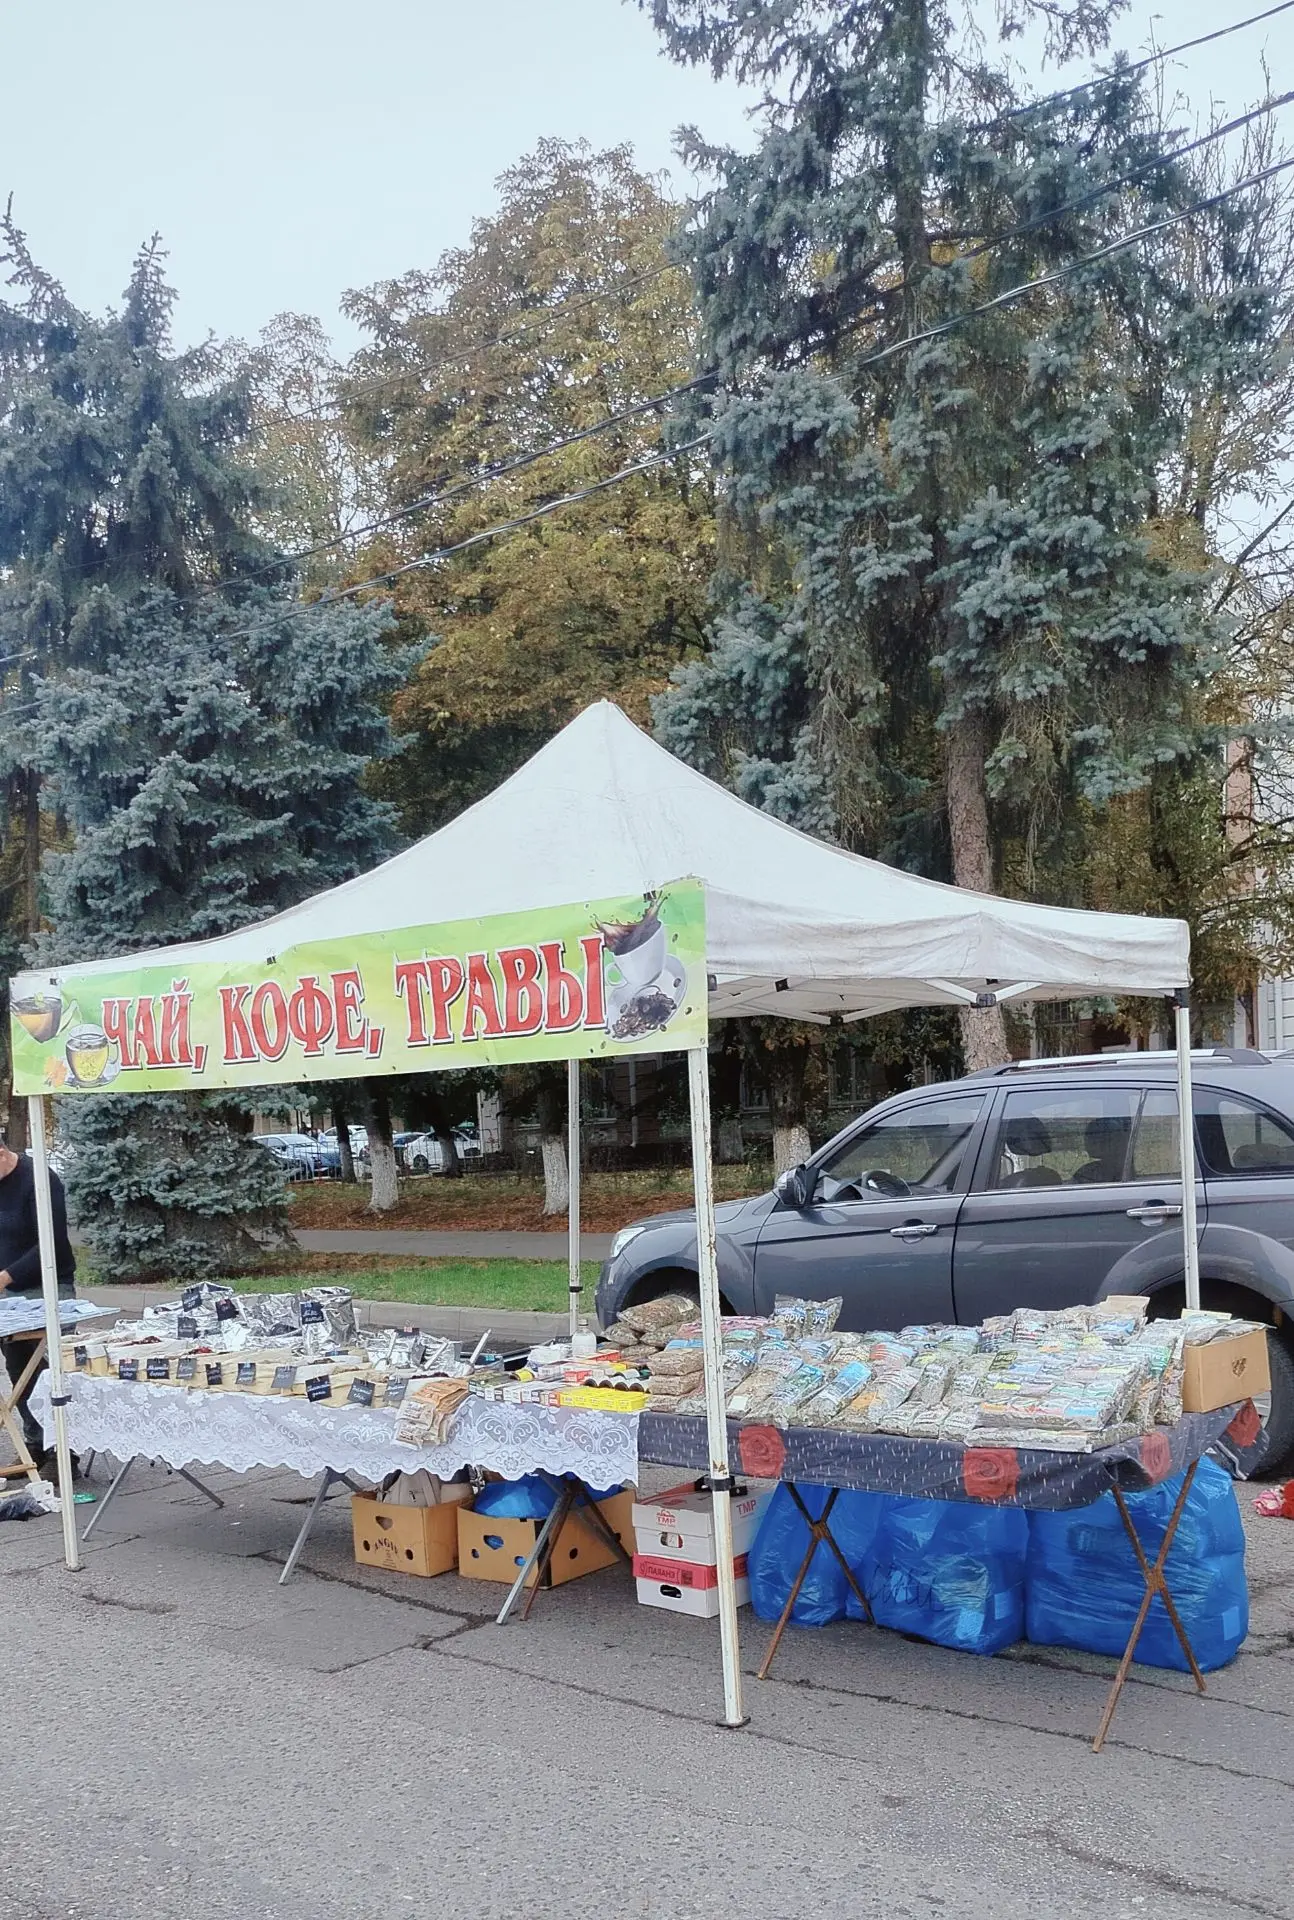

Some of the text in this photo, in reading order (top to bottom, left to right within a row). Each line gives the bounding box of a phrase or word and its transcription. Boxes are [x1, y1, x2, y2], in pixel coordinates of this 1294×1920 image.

[101, 936, 606, 1074] ЧАЙ, КОФЕ, ТРАВЫ
